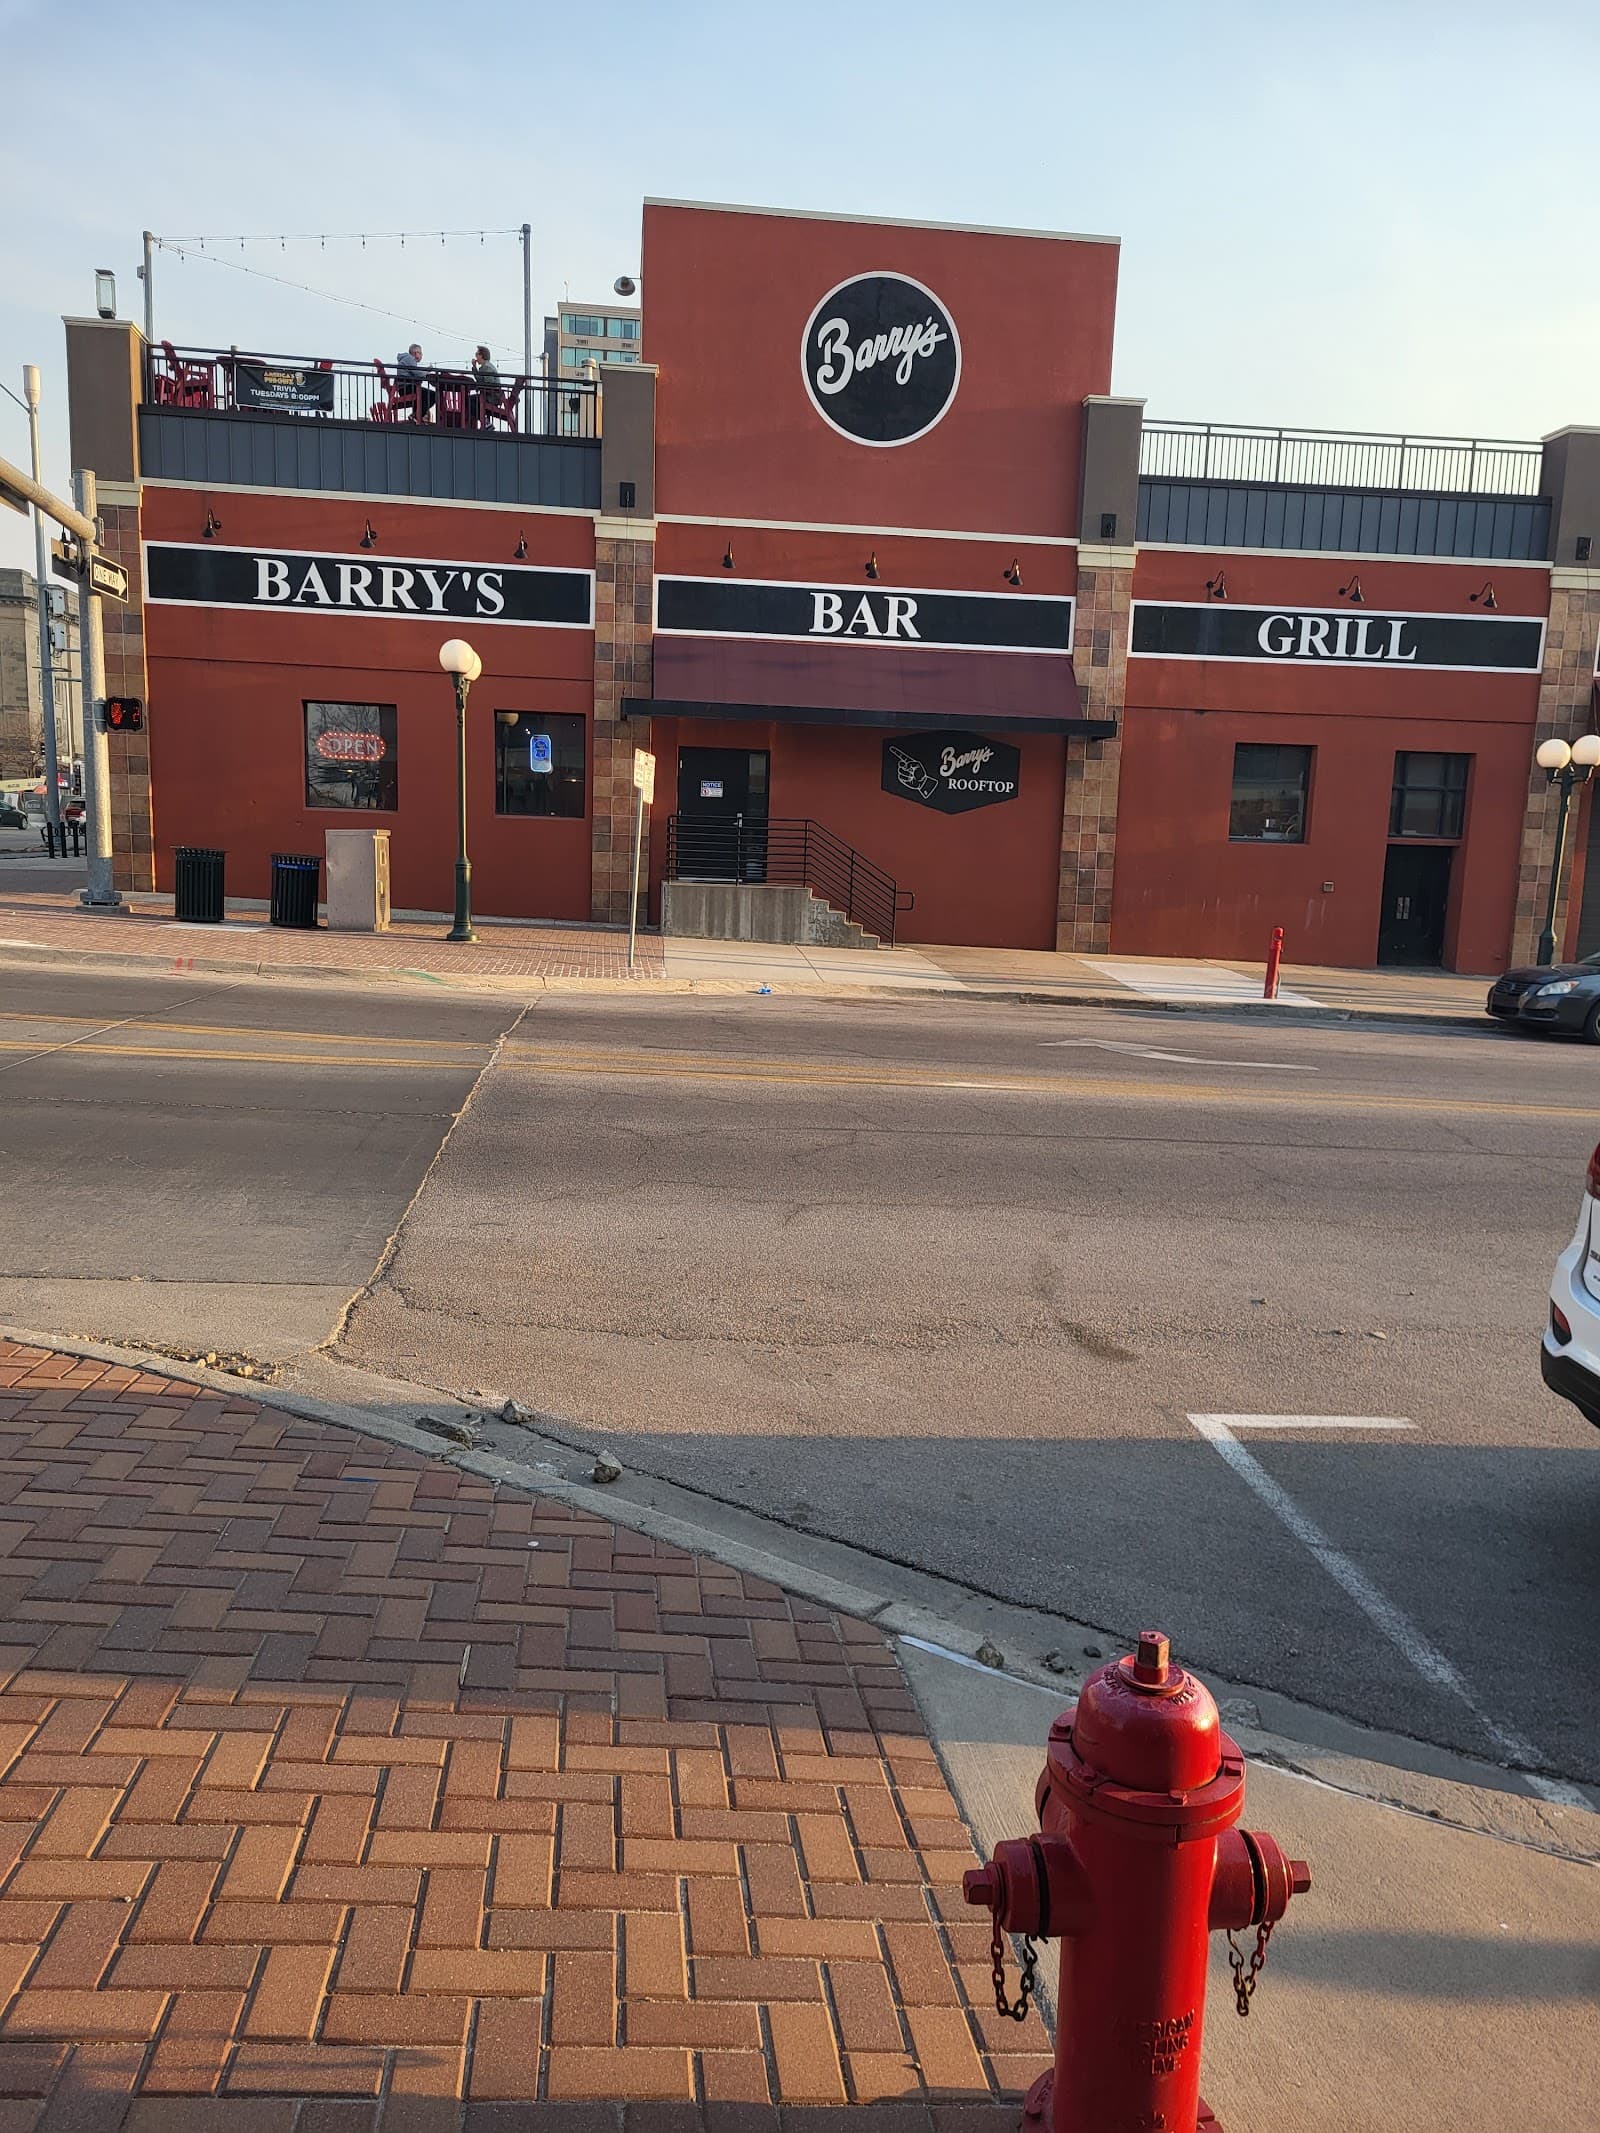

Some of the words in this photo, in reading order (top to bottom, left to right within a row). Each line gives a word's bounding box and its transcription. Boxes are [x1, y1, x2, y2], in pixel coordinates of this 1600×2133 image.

[816, 316, 947, 394] Barry's
[250, 389, 289, 399] TUESDAYS
[272, 385, 297, 393] TRIVIA
[95, 565, 107, 582] ONE
[108, 573, 119, 588] WAY
[252, 558, 505, 615] BARRY'S
[808, 592, 922, 638] BAR
[1257, 615, 1418, 660] GRILL
[326, 738, 377, 755] OPEN
[940, 746, 994, 776] Barry's
[948, 778, 1014, 793] ROOFTOP
